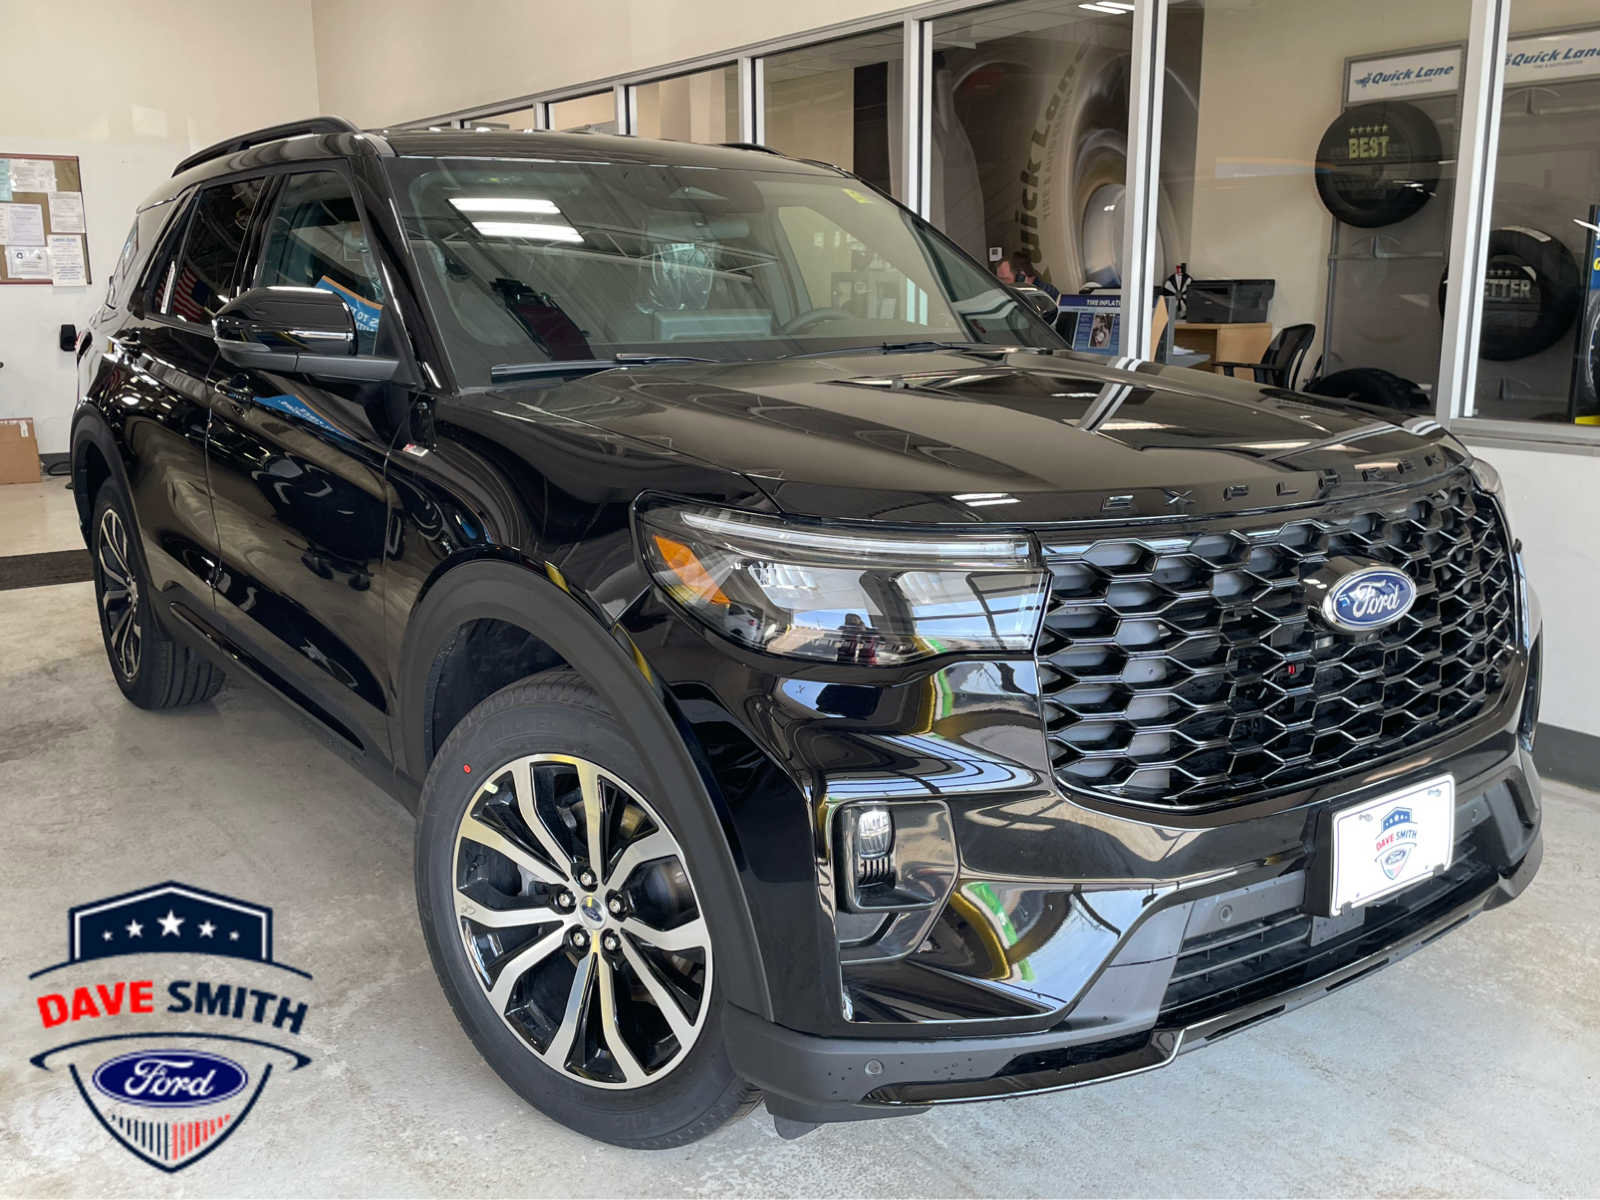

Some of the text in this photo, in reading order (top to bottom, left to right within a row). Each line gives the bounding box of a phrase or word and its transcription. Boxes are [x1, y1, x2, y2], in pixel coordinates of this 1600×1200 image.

[1511, 49, 1560, 66] Quick
[1372, 68, 1414, 84] Quick
[1415, 65, 1455, 78] Lane
[1348, 135, 1389, 159] BEST
[1015, 159, 1044, 267] uick
[1352, 579, 1400, 617] Ford
[1376, 829, 1416, 851] DAVE SMITH
